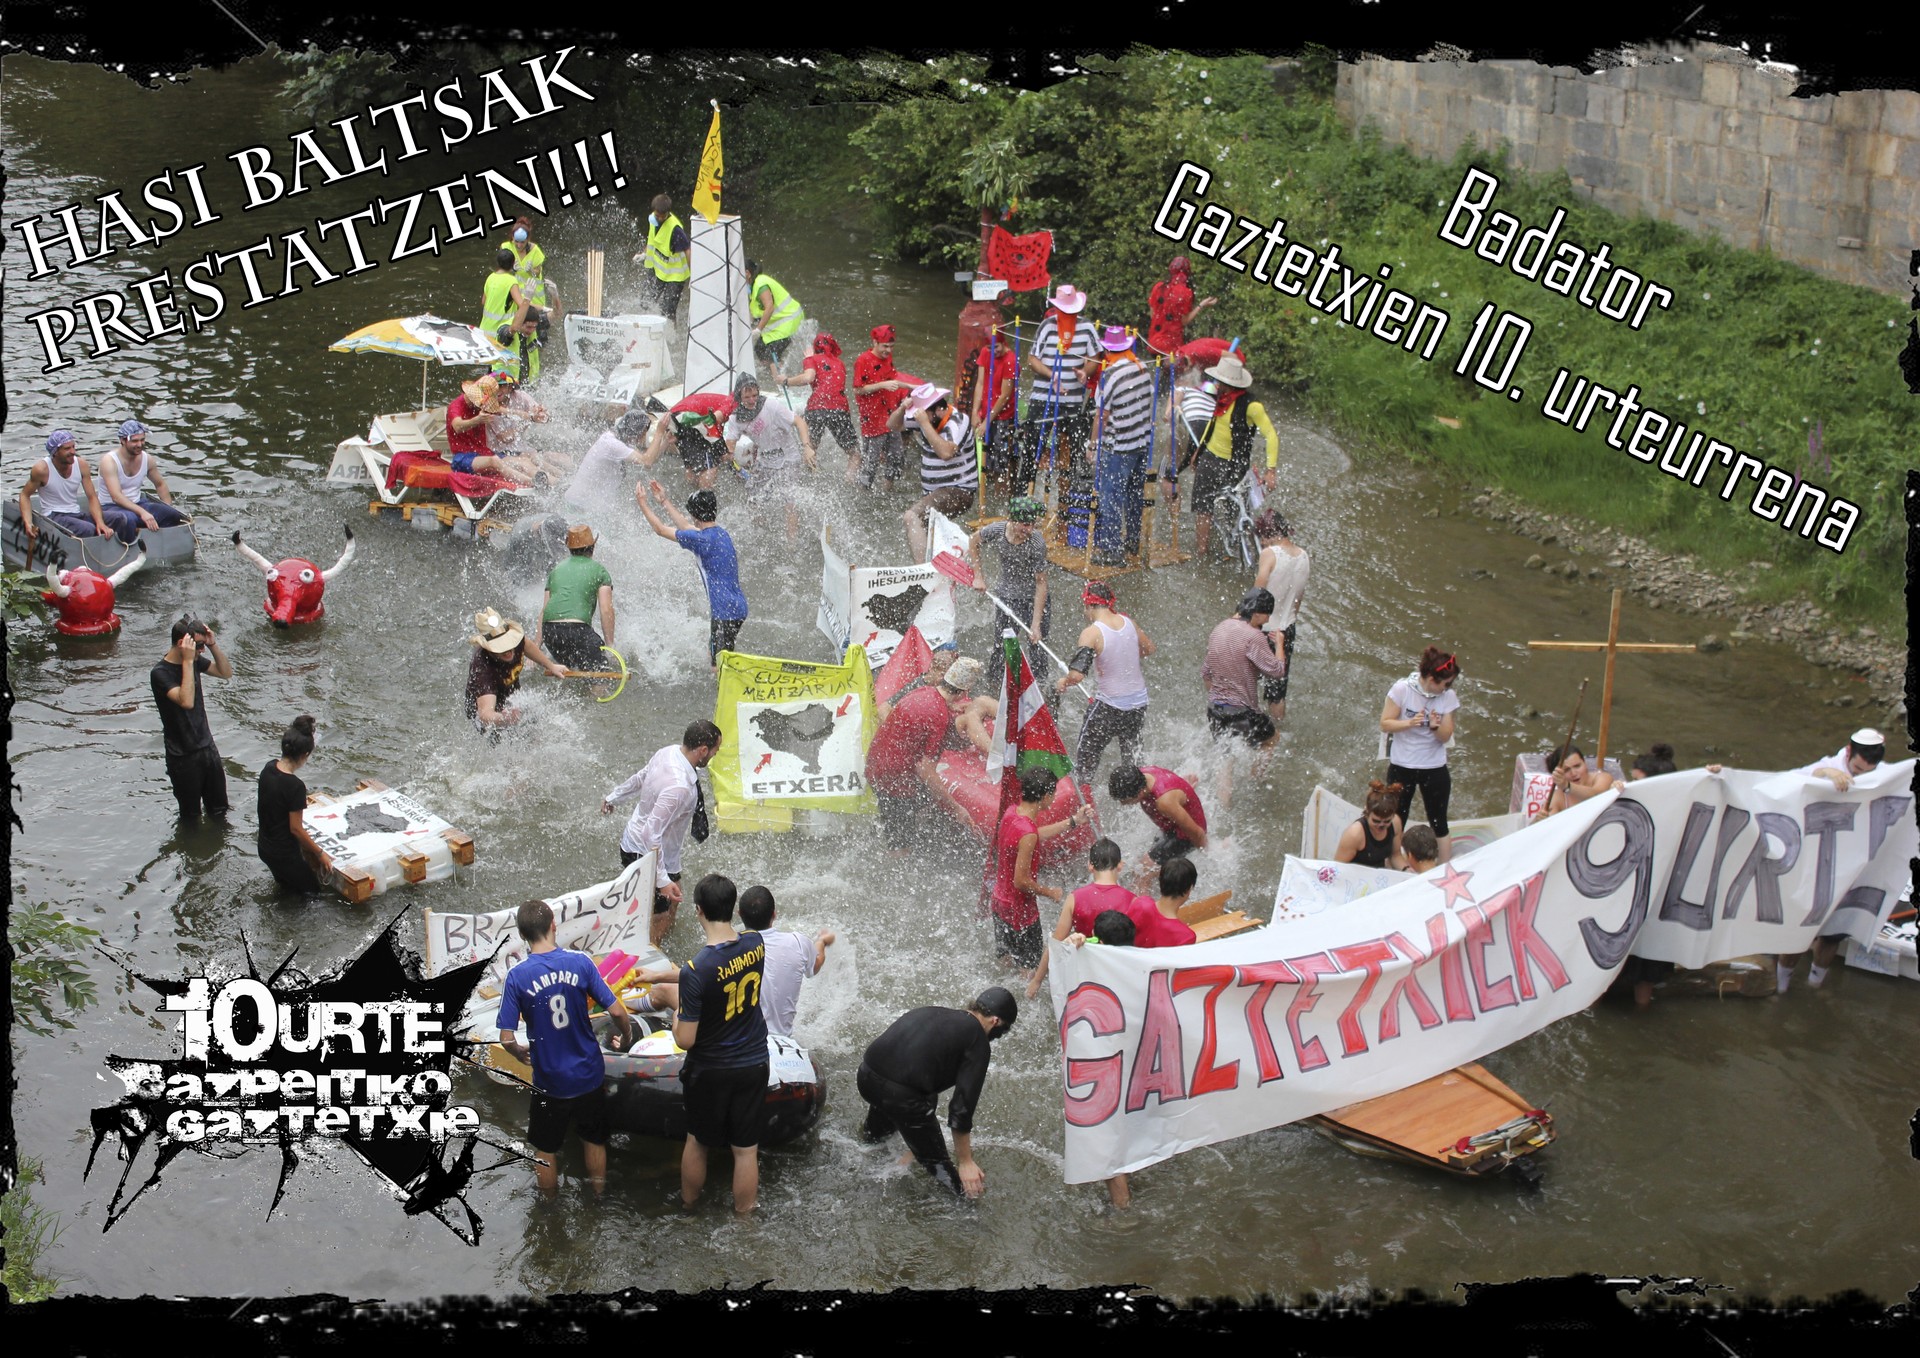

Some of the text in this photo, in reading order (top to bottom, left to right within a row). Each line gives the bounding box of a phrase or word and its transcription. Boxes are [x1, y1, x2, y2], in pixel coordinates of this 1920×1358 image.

[867, 571, 934, 589] IHESLARIAK
[751, 771, 863, 794] ETXERA
[1061, 872, 1571, 1127] GAZTETXIEK
[1566, 797, 1655, 971] 9
[526, 970, 579, 997] LAMPARD
[723, 971, 761, 1022] 10
[550, 994, 570, 1030] 8
